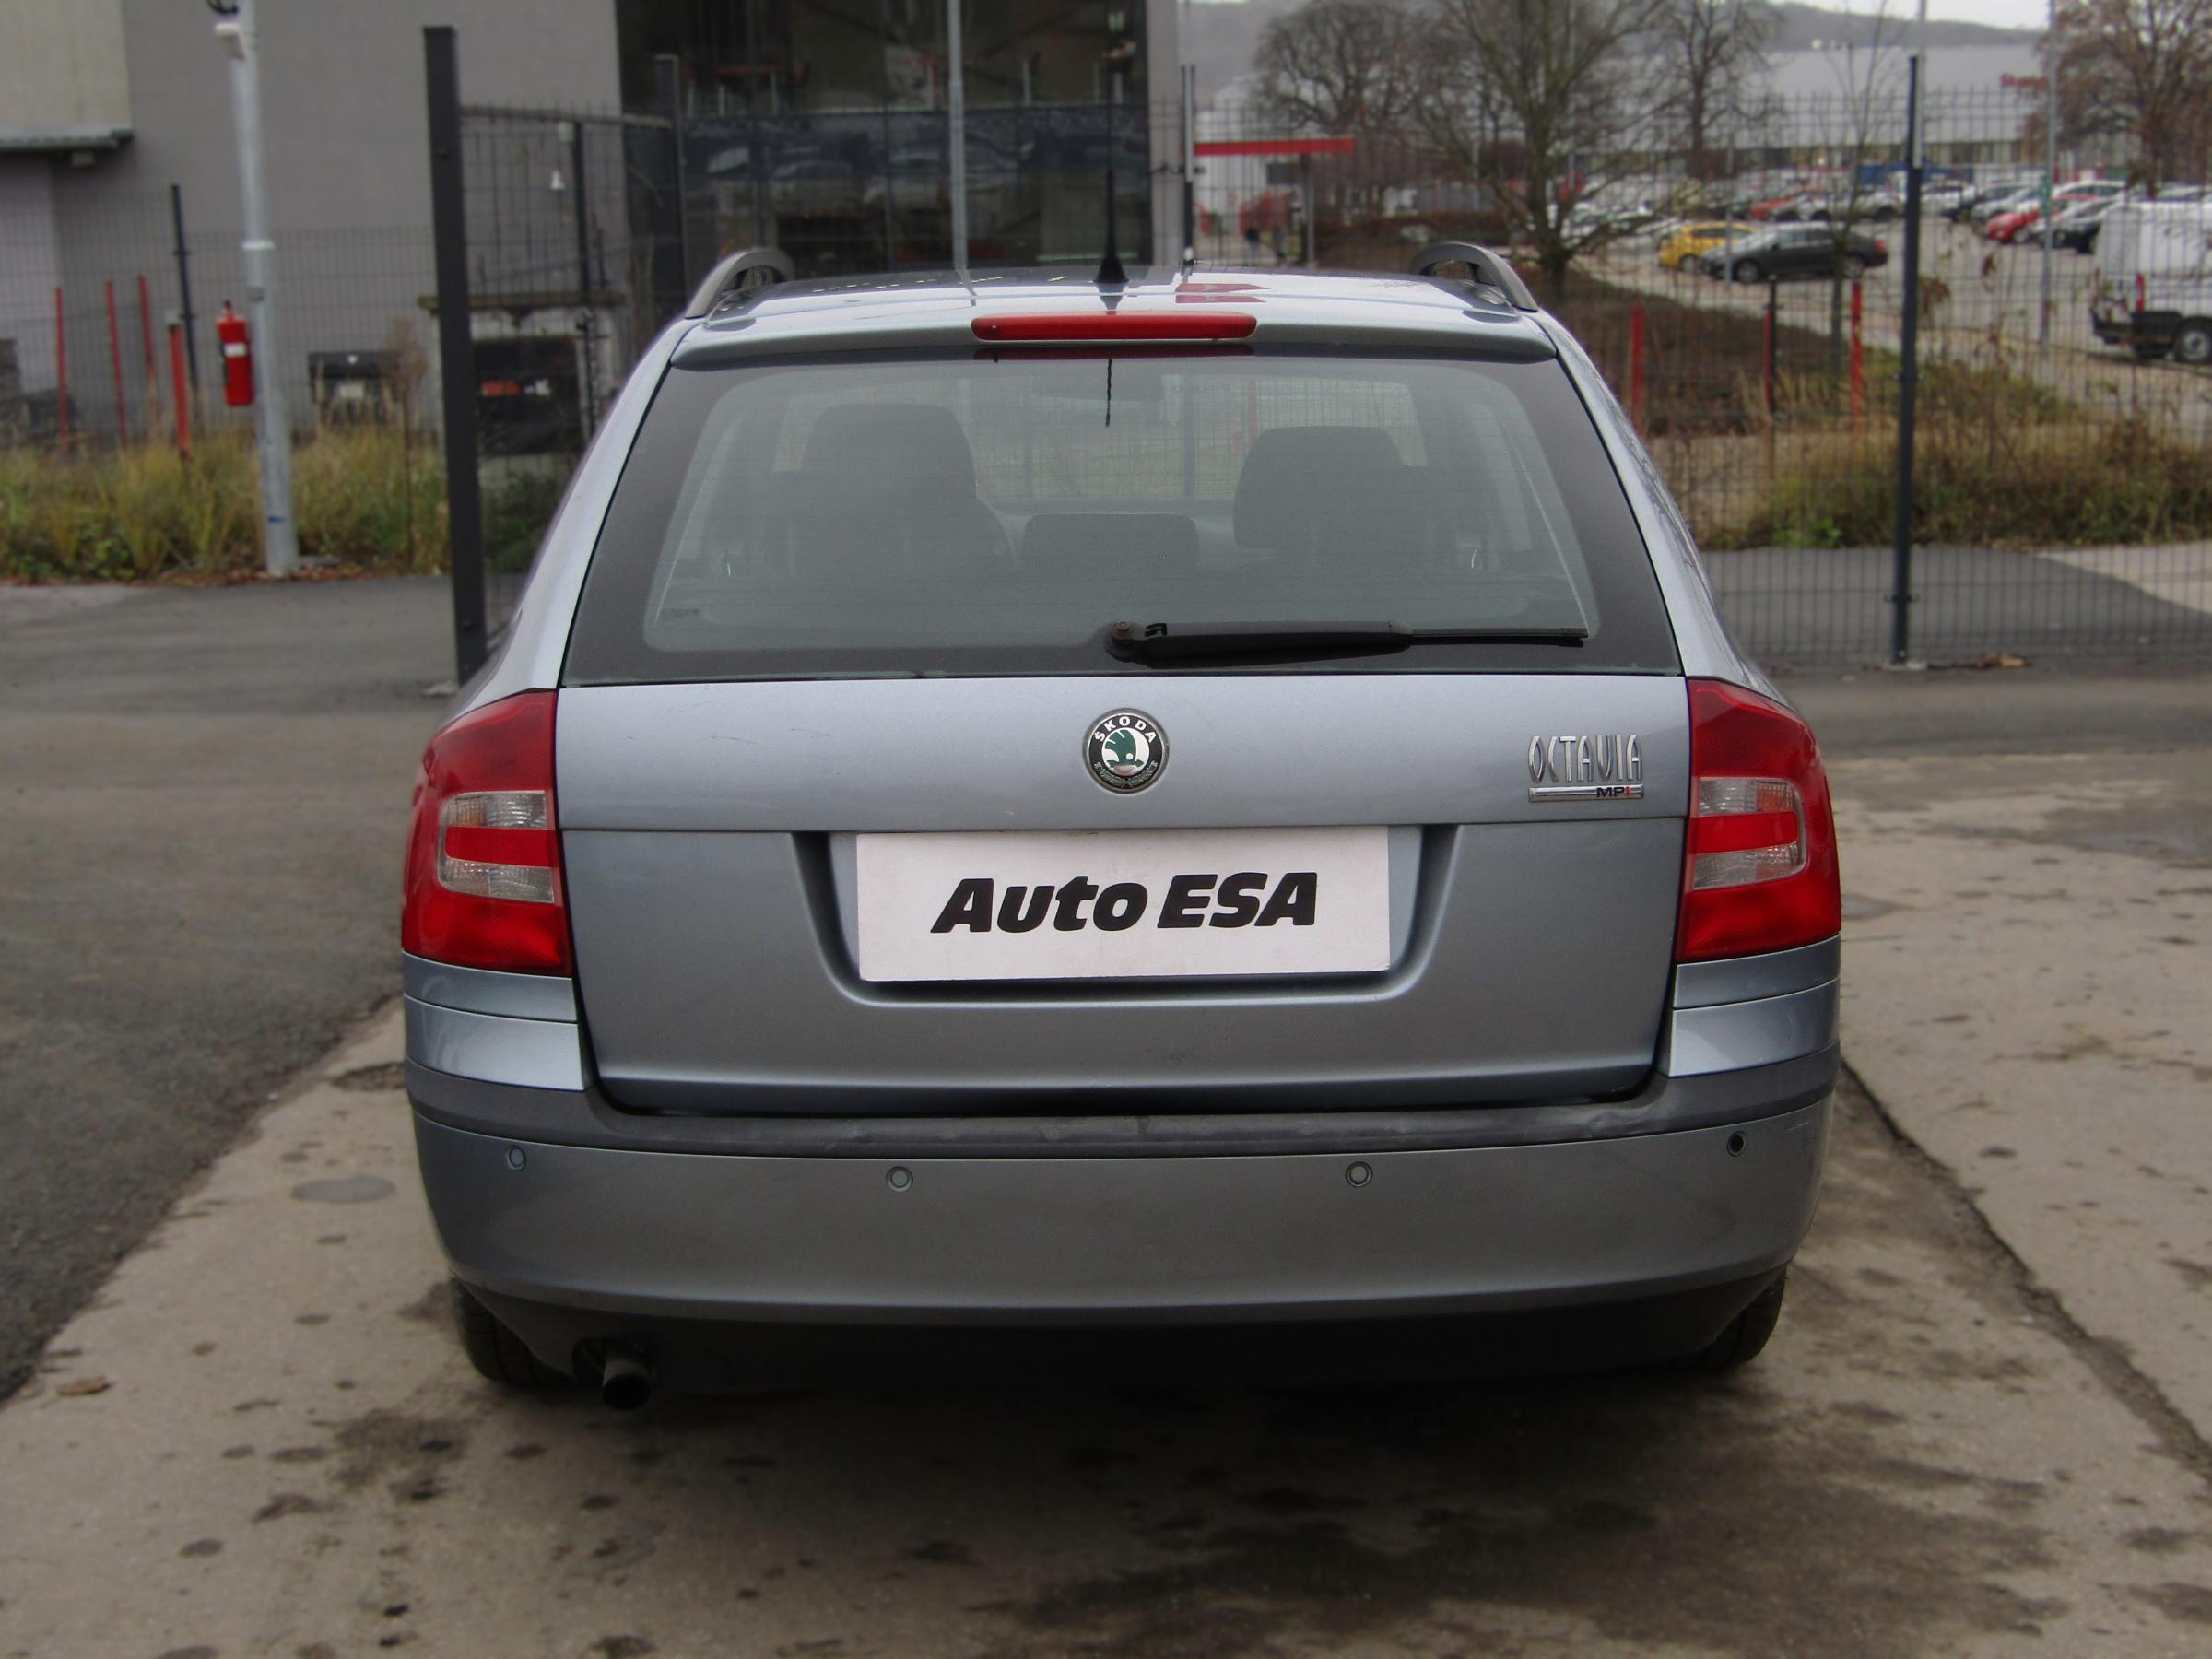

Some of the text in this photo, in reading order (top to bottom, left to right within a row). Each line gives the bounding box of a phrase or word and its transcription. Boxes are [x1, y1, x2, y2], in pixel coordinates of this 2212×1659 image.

[1529, 735, 1641, 782] OCTAVIA
[930, 872, 1318, 934] Auto ESA
